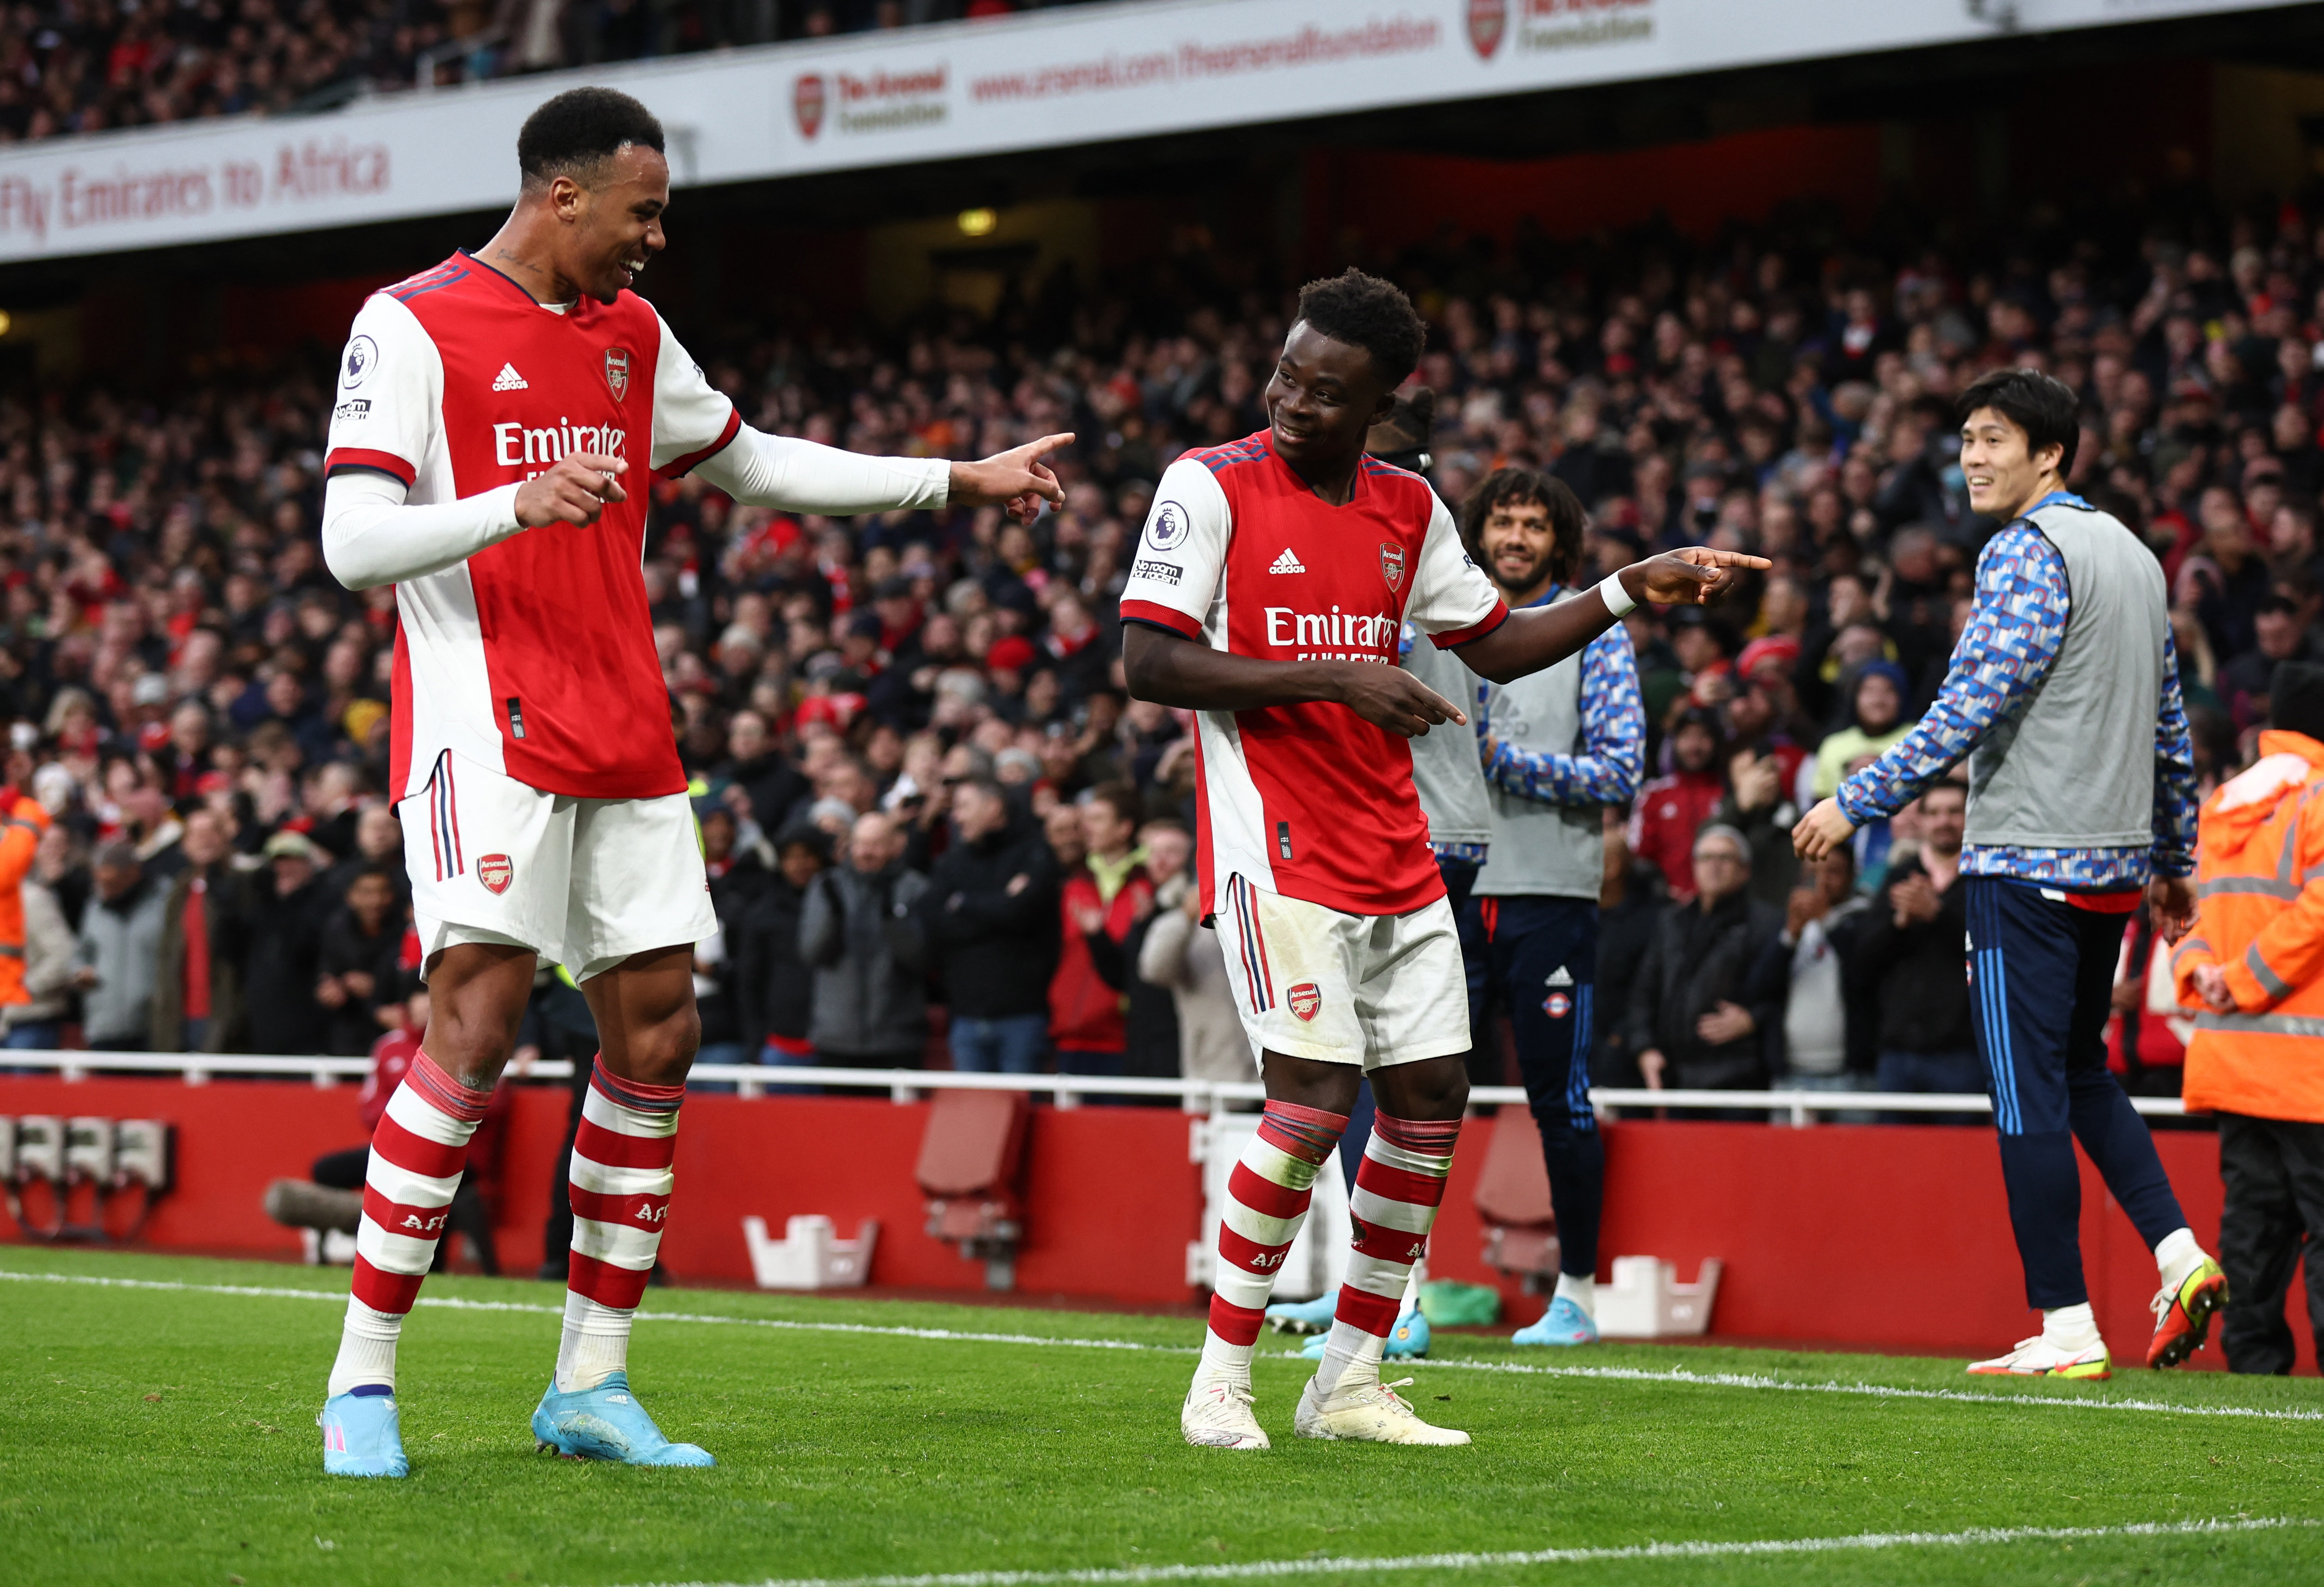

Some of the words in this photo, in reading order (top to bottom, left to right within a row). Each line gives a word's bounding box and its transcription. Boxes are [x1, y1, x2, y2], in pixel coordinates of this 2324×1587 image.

[61, 162, 214, 228] Emirates
[223, 160, 264, 208] to
[274, 135, 392, 204] Africa
[608, 356, 625, 366] Arsenal
[492, 380, 528, 392] adidas
[1173, 527, 1183, 542] League
[1383, 550, 1401, 561] Arsenal
[1135, 560, 1149, 570] No
[1149, 563, 1177, 576] room
[1269, 564, 1305, 574] adidas
[1132, 568, 1146, 577] for
[1145, 571, 1180, 585] racism
[482, 859, 508, 868] Arsenal
[1291, 988, 1316, 998] Arsenal
